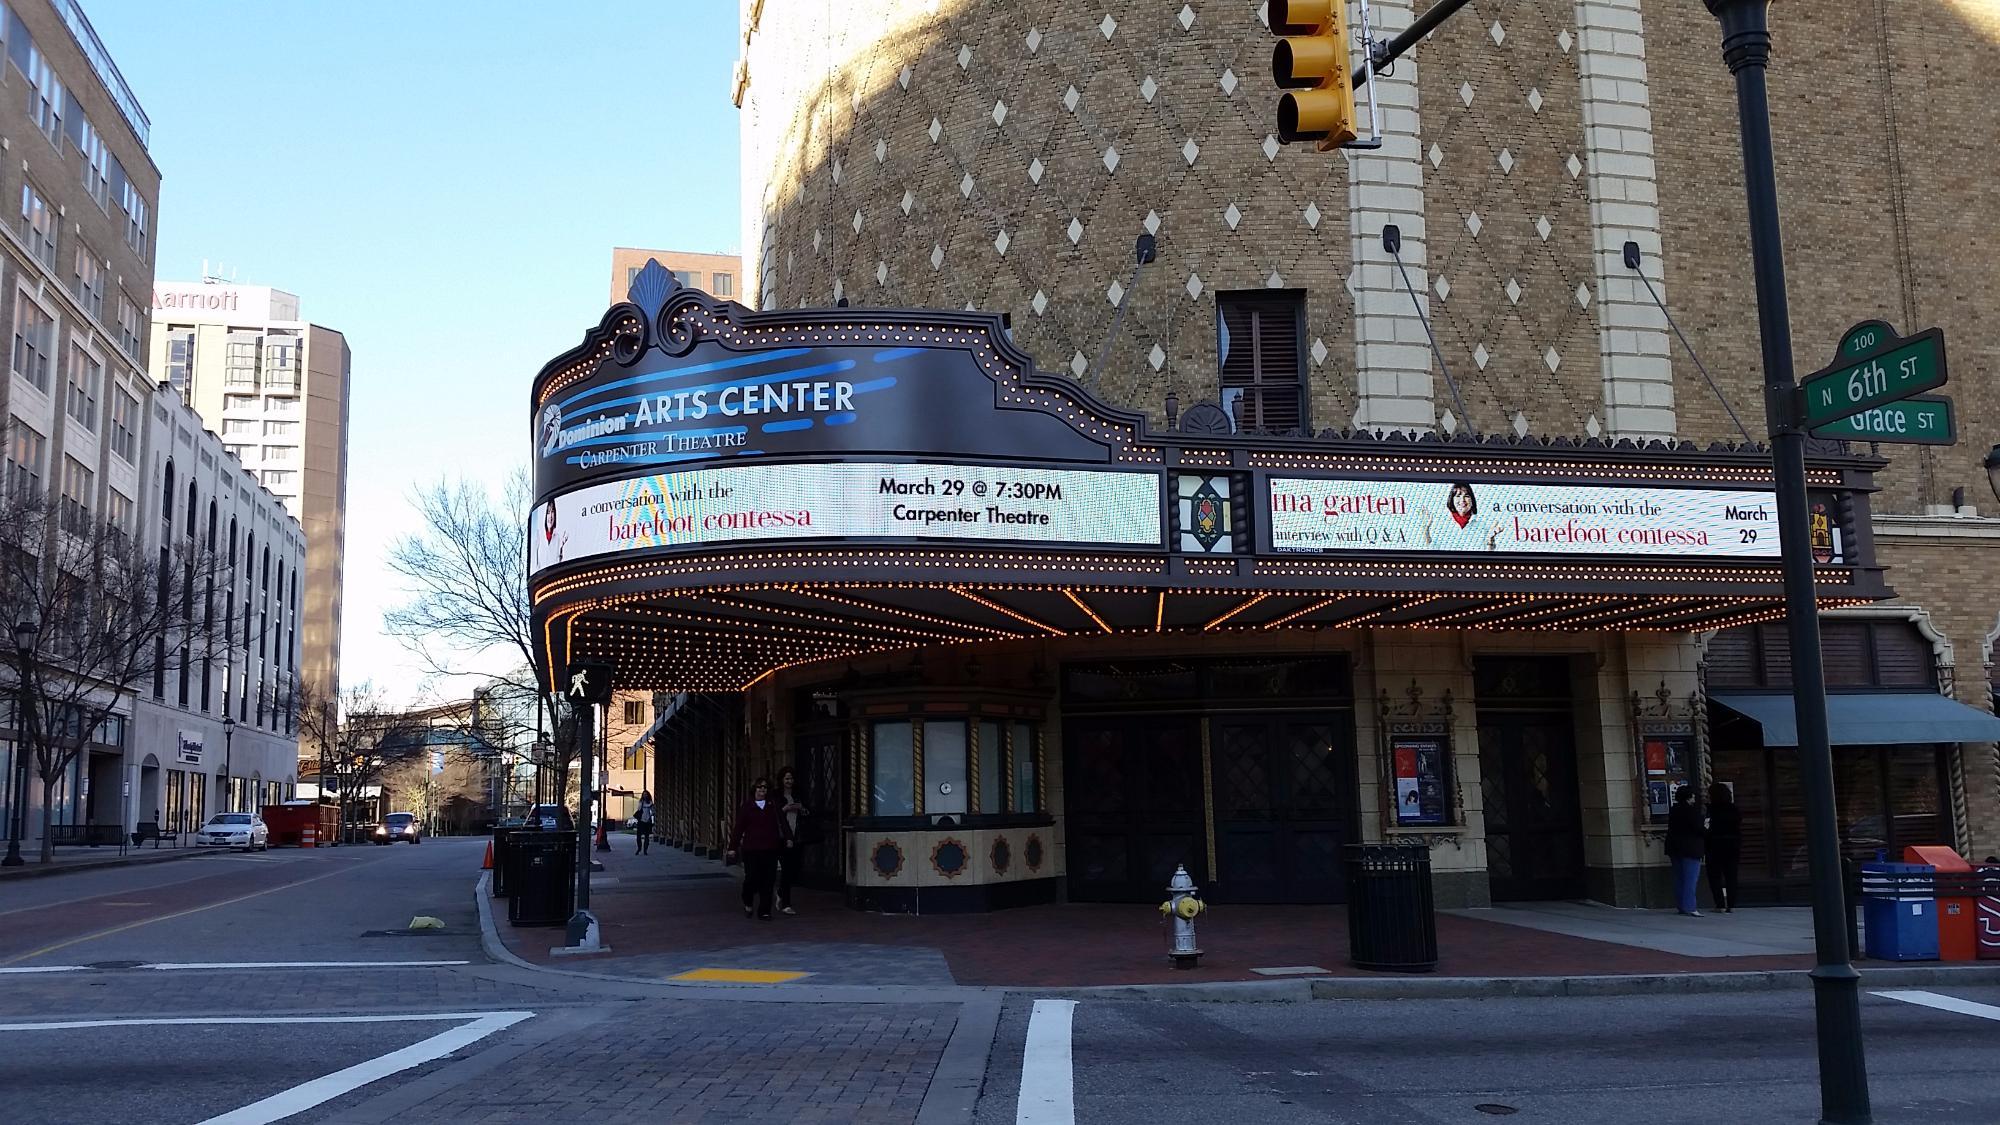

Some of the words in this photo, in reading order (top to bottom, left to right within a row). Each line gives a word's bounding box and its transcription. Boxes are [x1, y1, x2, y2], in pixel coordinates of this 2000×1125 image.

[1854, 332, 1875, 351] 100
[1822, 388, 1832, 406] N
[1847, 360, 1887, 402] 6th
[1900, 356, 1918, 379] ST
[558, 416, 626, 450] Dominion
[634, 390, 708, 427] ARTS
[719, 381, 856, 416] CENTER
[1850, 408, 1906, 433] Grace
[1918, 413, 1935, 429] ST
[580, 443, 657, 470] CARPENTER
[664, 431, 747, 453] THEATRE
[581, 506, 588, 517] a
[590, 488, 664, 516] conversation
[669, 484, 703, 502] with
[709, 481, 733, 499] the
[879, 477, 935, 496] March
[942, 480, 965, 496] 29
[972, 481, 988, 497] @
[995, 482, 1062, 500] 7:30PM
[893, 504, 980, 525] Carpenter
[986, 507, 1050, 525] Theatre
[1324, 493, 1407, 525] garten
[1493, 503, 1501, 513] a
[1506, 500, 1596, 515] conversation
[1602, 500, 1635, 516] with
[1639, 500, 1662, 517] the
[1725, 505, 1768, 521] March
[609, 510, 694, 541] barefoot
[704, 509, 812, 531] contessa
[1276, 526, 1331, 542] interview
[1336, 526, 1362, 542] with
[1366, 527, 1378, 544] Q
[1383, 528, 1392, 543] &
[1397, 527, 1407, 543] A
[1514, 516, 1609, 544] barefoot
[1618, 525, 1709, 546] contessa
[1740, 529, 1758, 544] 29
